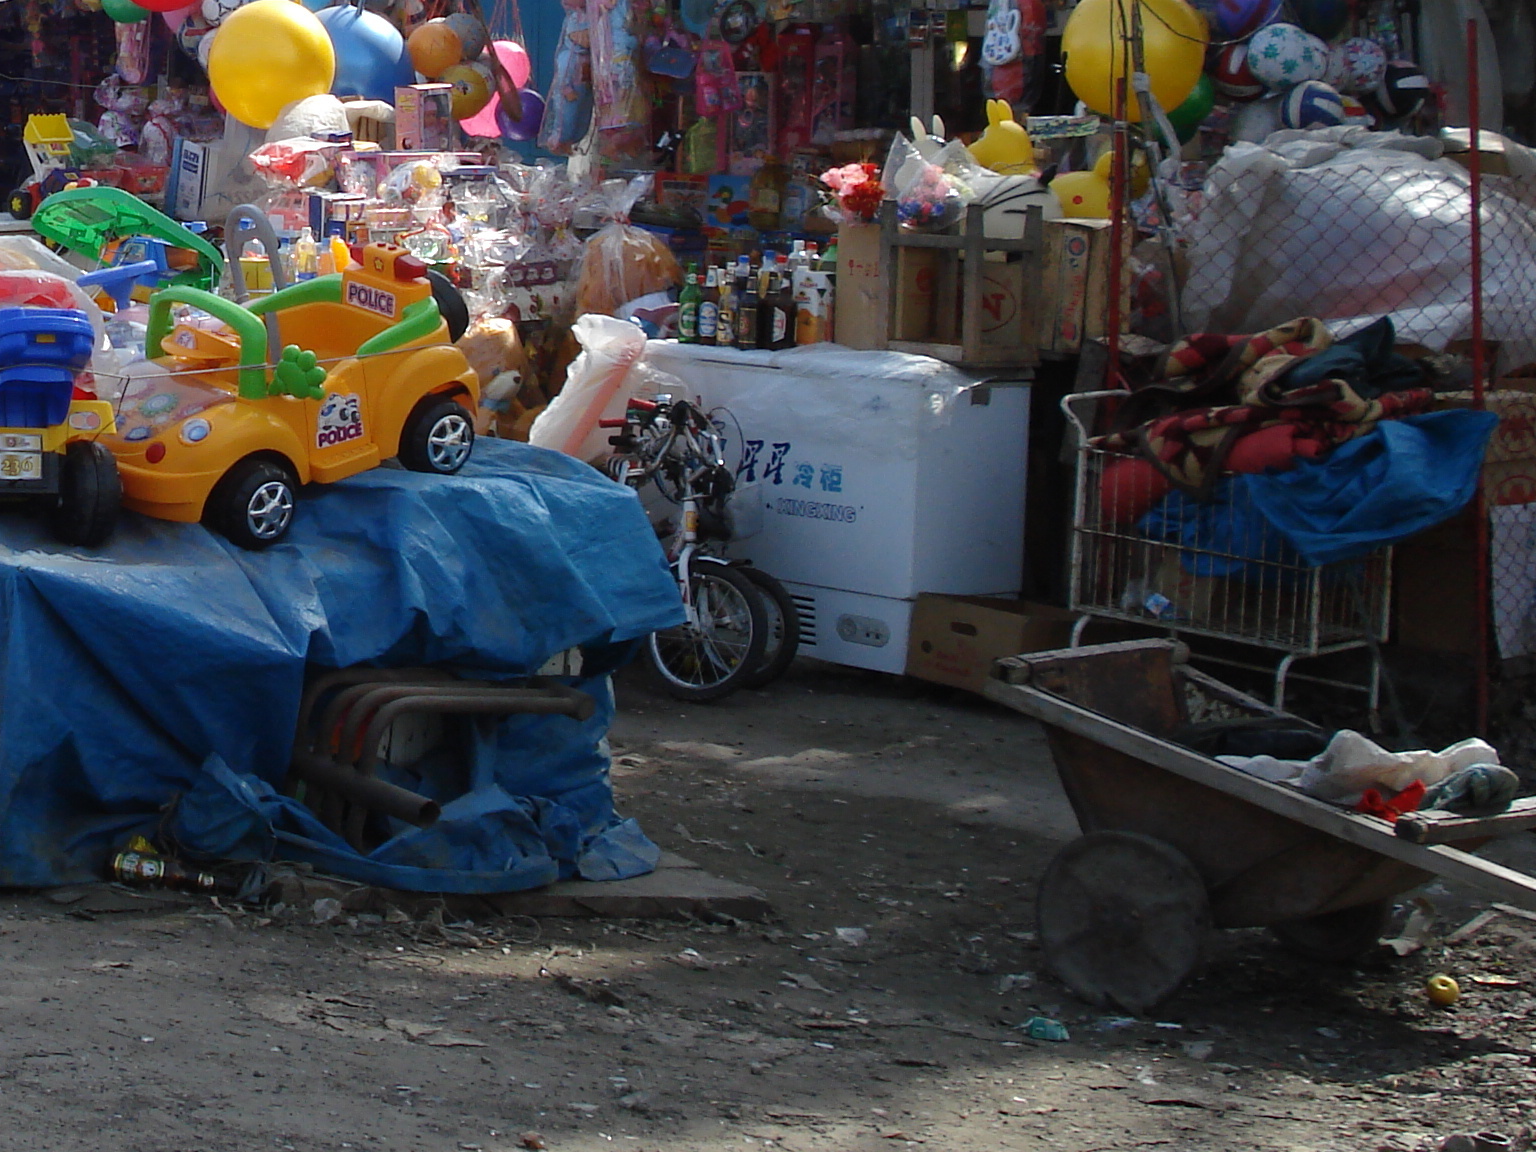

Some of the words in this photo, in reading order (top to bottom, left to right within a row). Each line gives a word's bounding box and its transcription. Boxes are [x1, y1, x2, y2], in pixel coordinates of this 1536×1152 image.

[348, 282, 394, 315] POLICE
[318, 422, 363, 448] POLICE
[1, 456, 33, 476] 236
[776, 497, 857, 523] XINGXING
